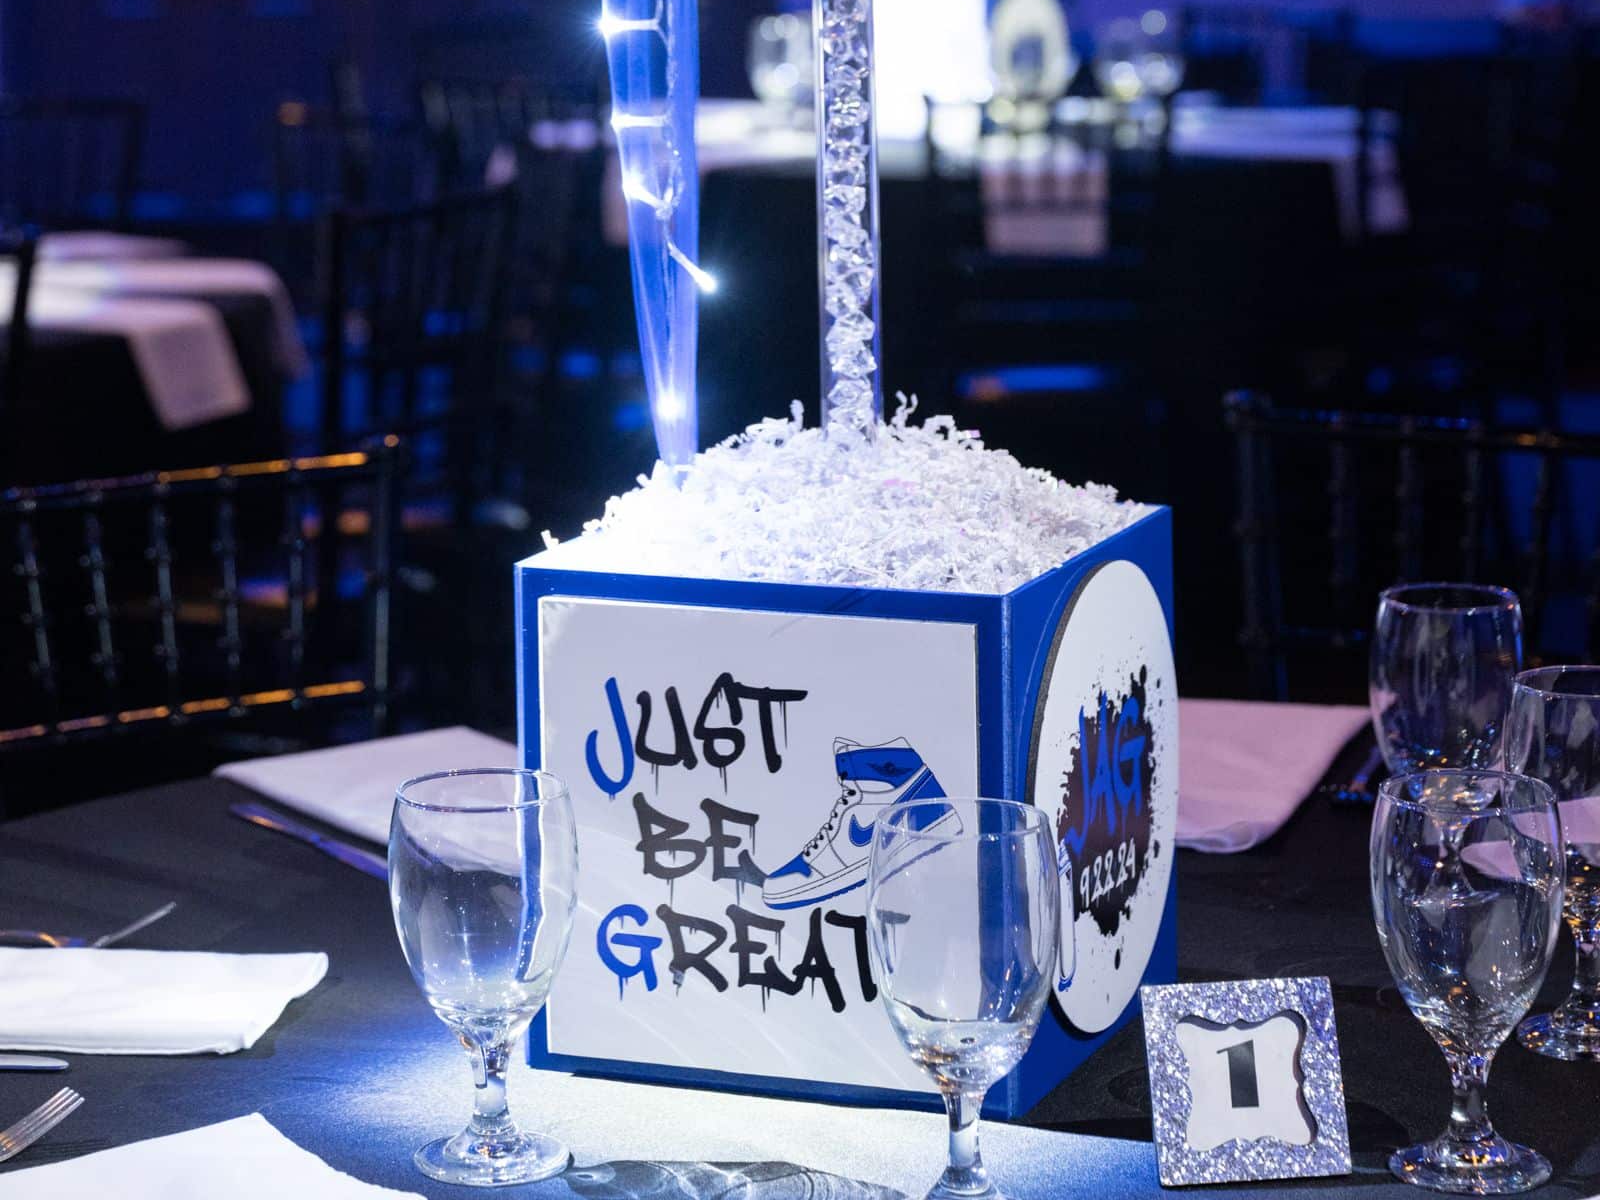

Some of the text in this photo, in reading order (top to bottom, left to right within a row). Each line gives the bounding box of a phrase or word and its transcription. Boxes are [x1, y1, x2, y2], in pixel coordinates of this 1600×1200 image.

[585, 672, 808, 800] JUST
[1064, 690, 1147, 857] JAG
[632, 792, 765, 898] BE
[596, 903, 911, 1014] GREAT
[1216, 1039, 1260, 1108] 1
